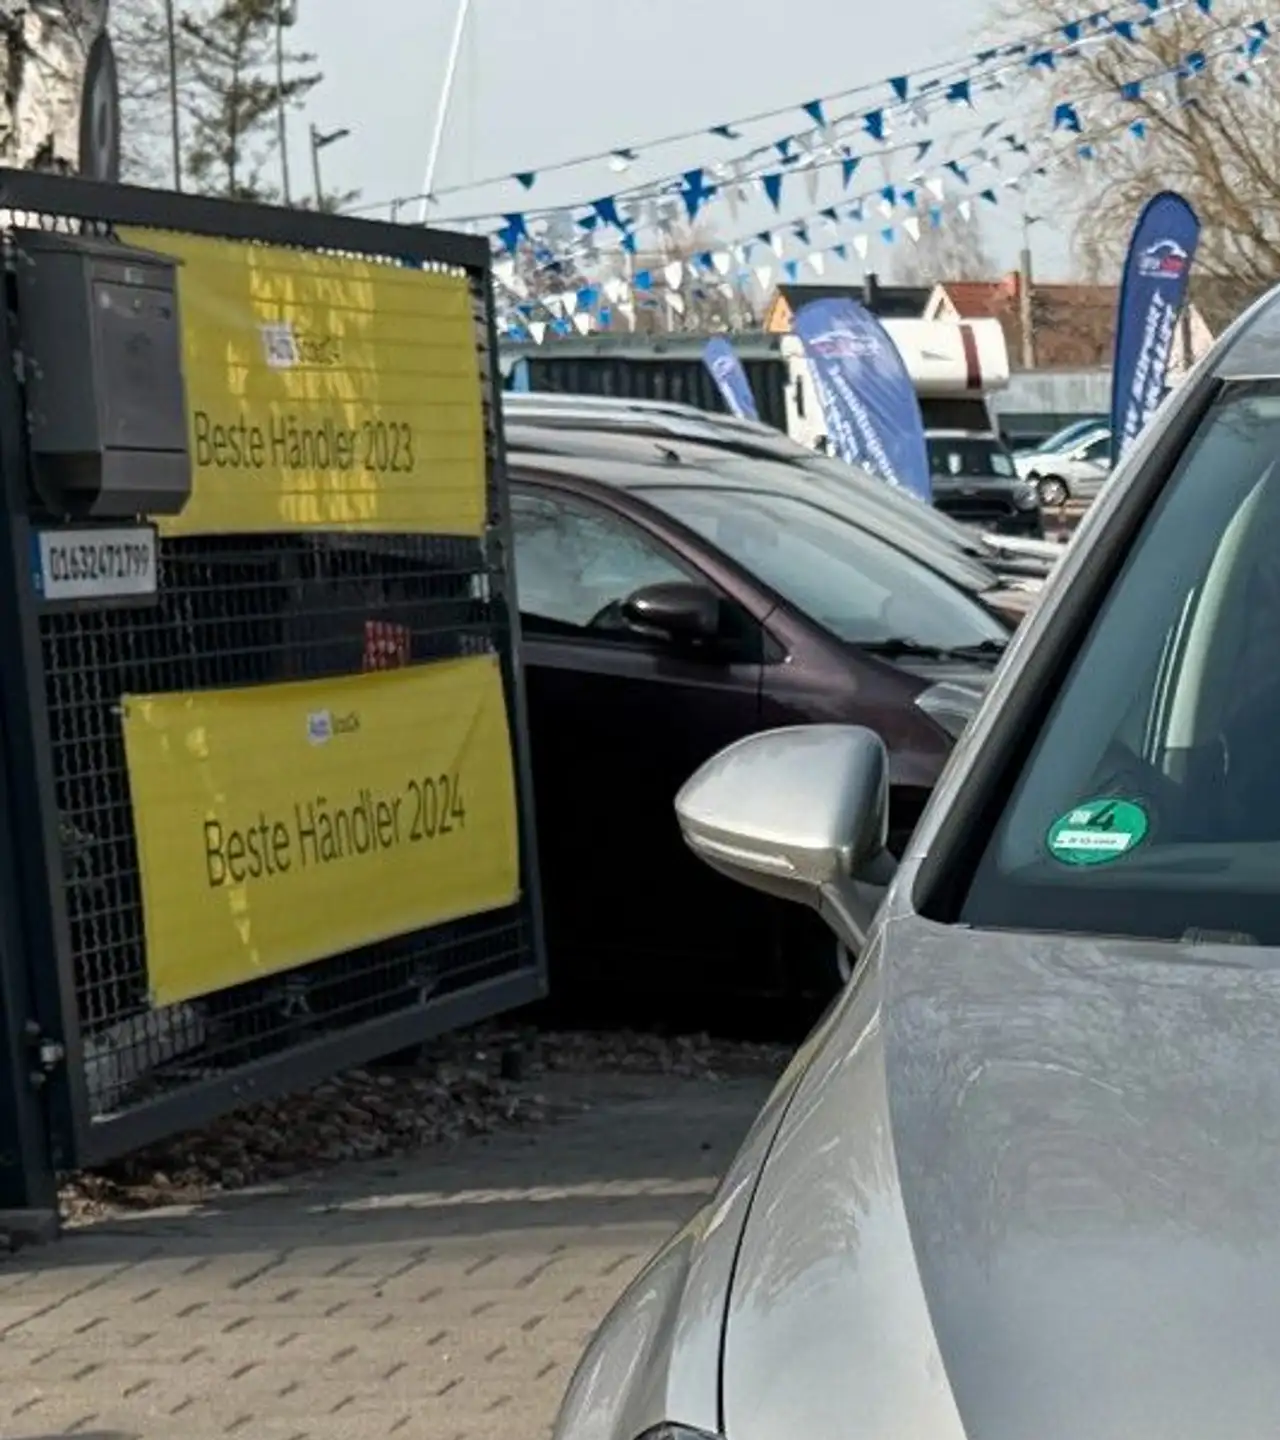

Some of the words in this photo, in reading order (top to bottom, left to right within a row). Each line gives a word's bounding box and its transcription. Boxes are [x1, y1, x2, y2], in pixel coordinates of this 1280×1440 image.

[194, 410, 264, 469] Beste
[269, 413, 356, 471] Händler
[363, 420, 414, 472] 2023
[205, 818, 291, 888] Beste
[295, 788, 402, 867] Händler
[408, 773, 465, 842] 2024
